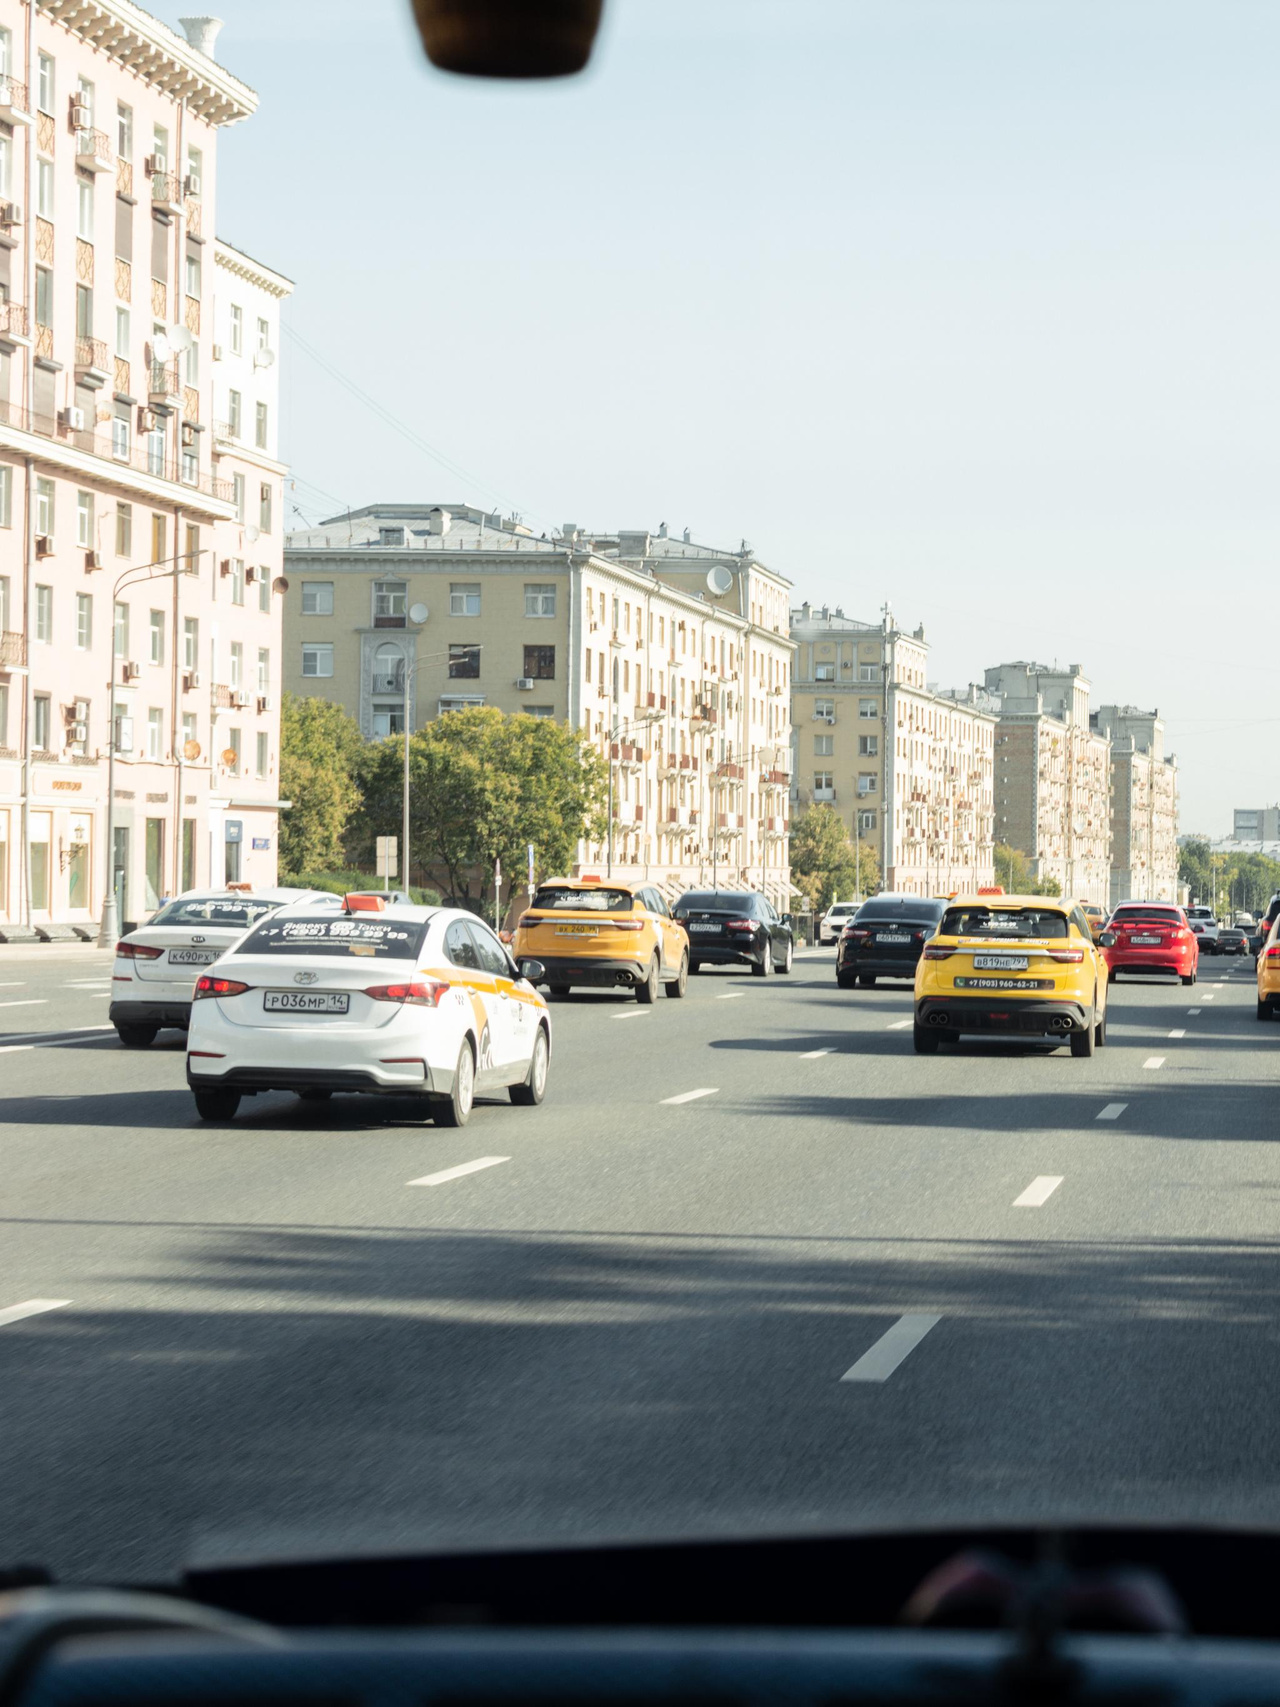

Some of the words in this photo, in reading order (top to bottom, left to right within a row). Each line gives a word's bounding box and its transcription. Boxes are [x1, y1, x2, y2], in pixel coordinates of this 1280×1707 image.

[283, 922, 328, 930] Яндекс
[358, 923, 391, 932] Такси
[259, 928, 279, 936] +7
[330, 929, 360, 937] 999
[363, 930, 384, 938] 99
[387, 931, 408, 940] 99
[979, 980, 998, 988] (903)
[1000, 980, 1039, 988] 960-62-21
[330, 995, 343, 1006] 14
